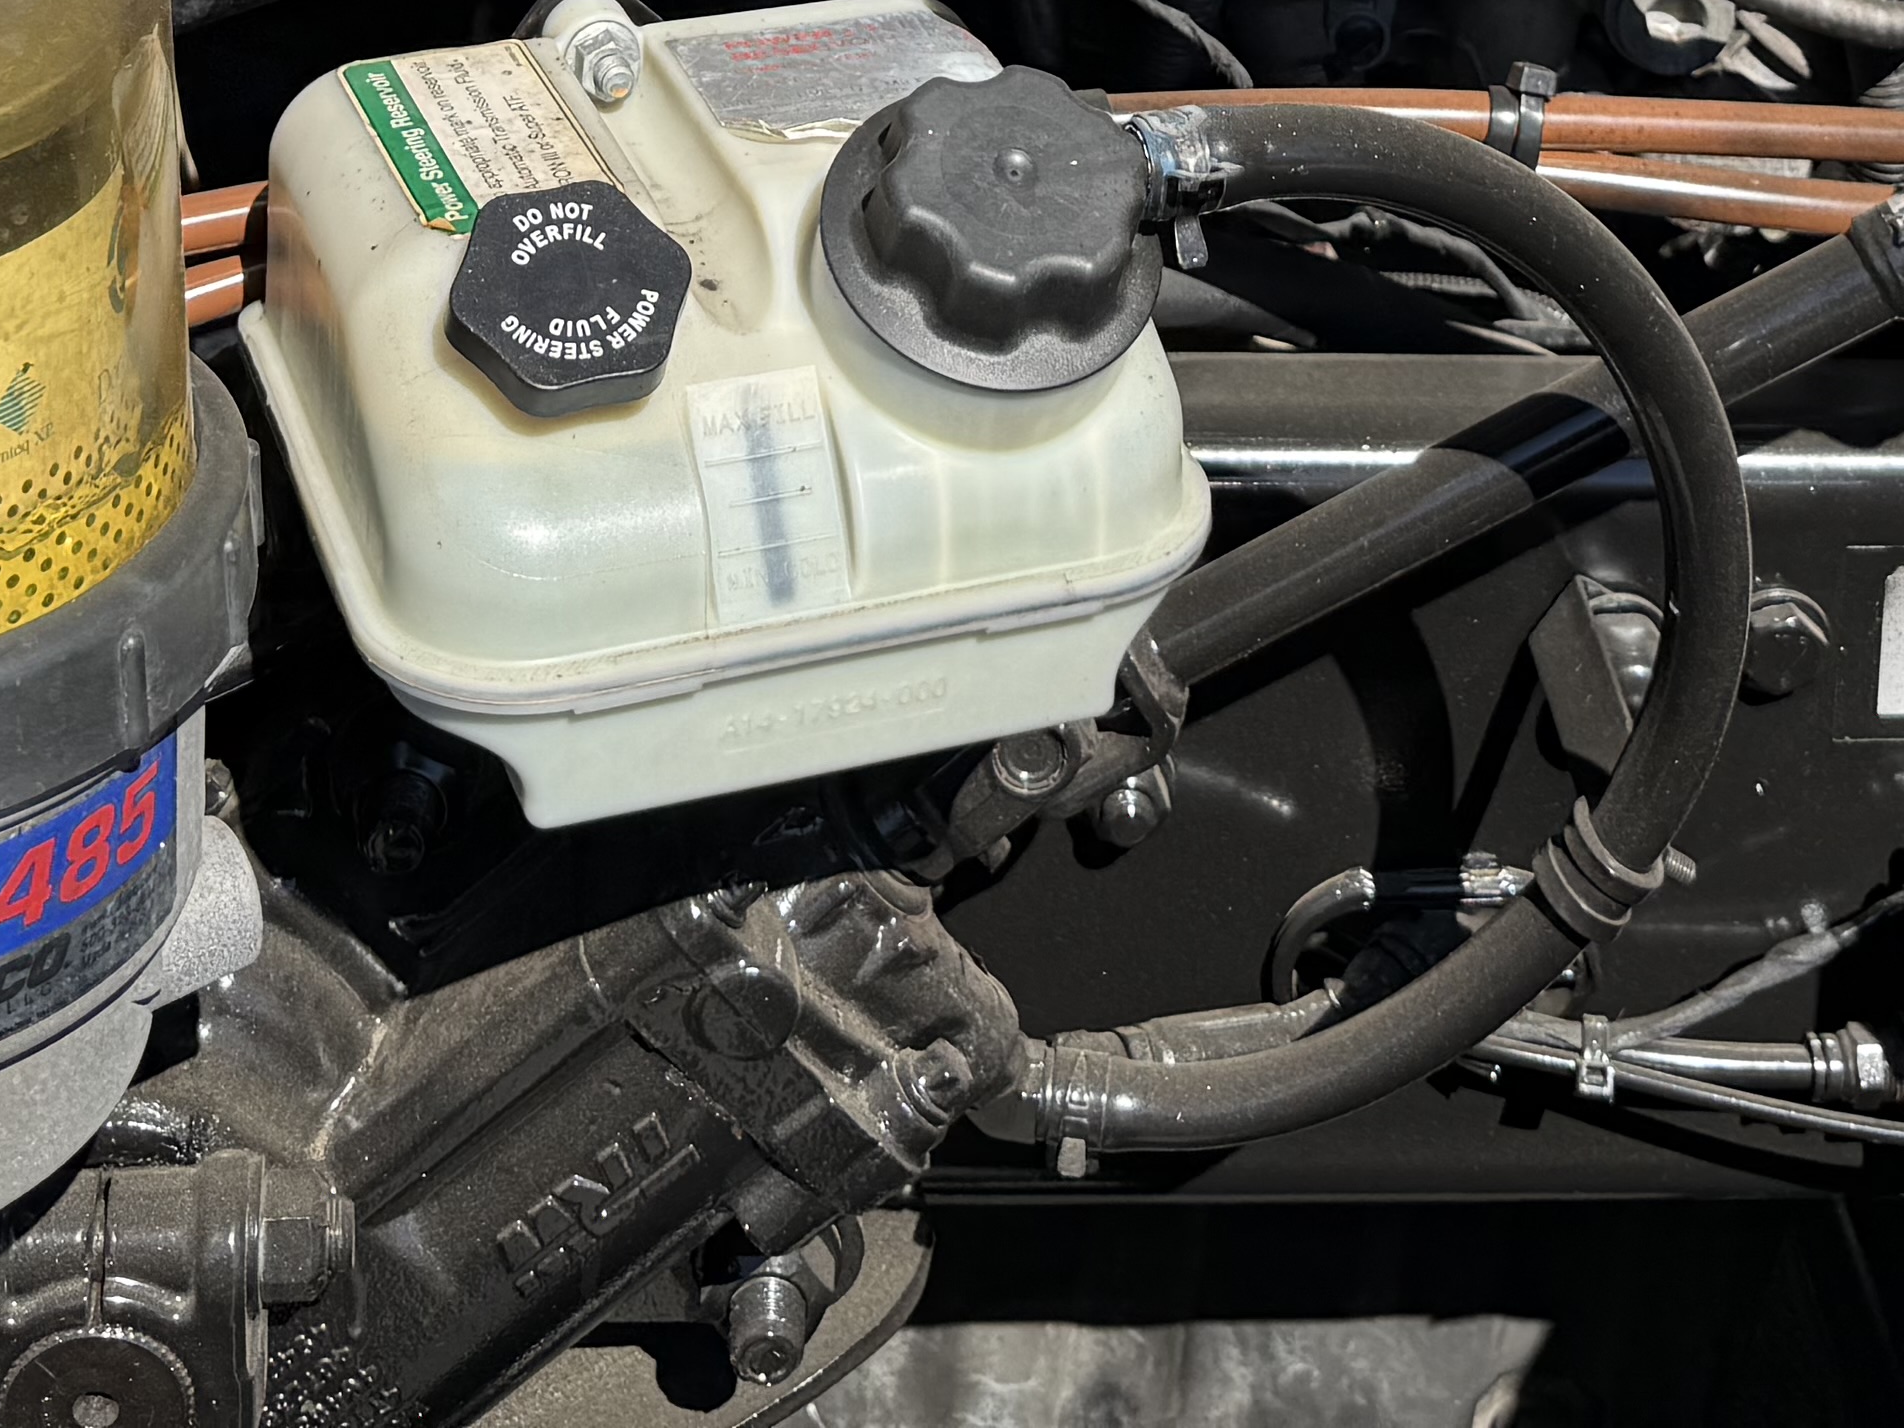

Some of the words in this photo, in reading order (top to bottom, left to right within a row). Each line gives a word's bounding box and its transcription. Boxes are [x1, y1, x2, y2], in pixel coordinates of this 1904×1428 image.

[365, 71, 413, 130] Reservoir
[412, 60, 445, 104] reservoir
[464, 82, 510, 145] Transmission
[400, 120, 444, 182] Steering
[432, 181, 469, 222] Power
[512, 207, 543, 233] DO
[549, 201, 594, 221] NOT
[511, 223, 607, 266] OVERFILL
[500, 314, 604, 360] STEERING
[548, 305, 621, 337] FLUID
[606, 288, 660, 349] POWER
[703, 408, 750, 437] MAX
